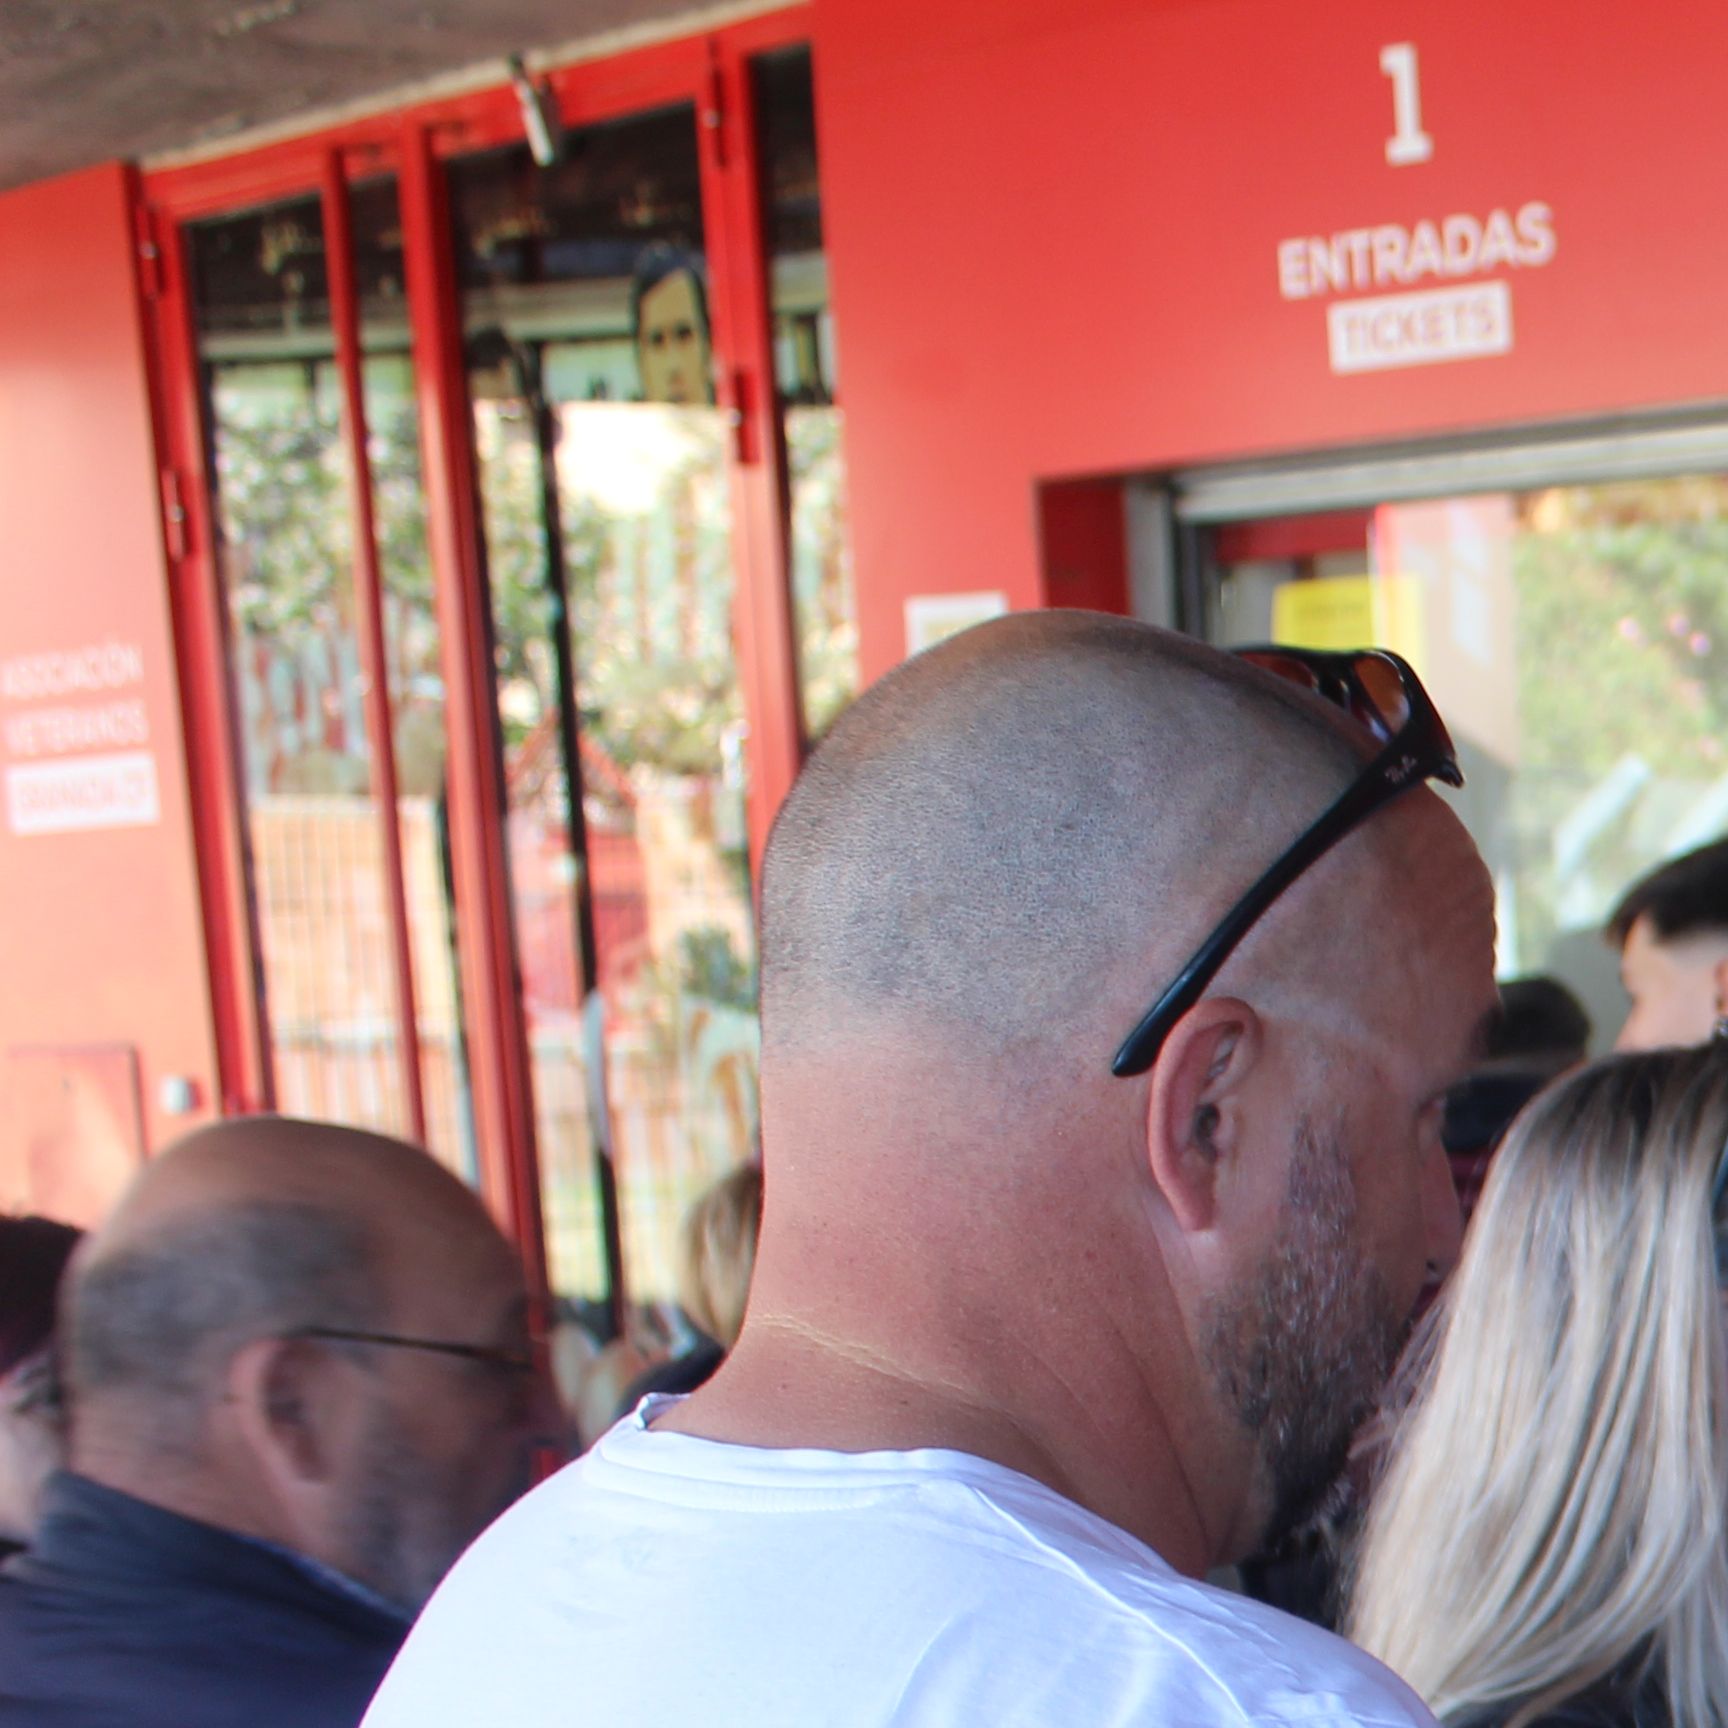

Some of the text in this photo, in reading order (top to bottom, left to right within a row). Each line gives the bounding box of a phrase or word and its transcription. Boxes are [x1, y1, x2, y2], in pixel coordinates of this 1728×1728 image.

[1380, 43, 1433, 166] 1
[1277, 200, 1558, 300] ENTRADAS
[1343, 300, 1497, 354] TICKETS
